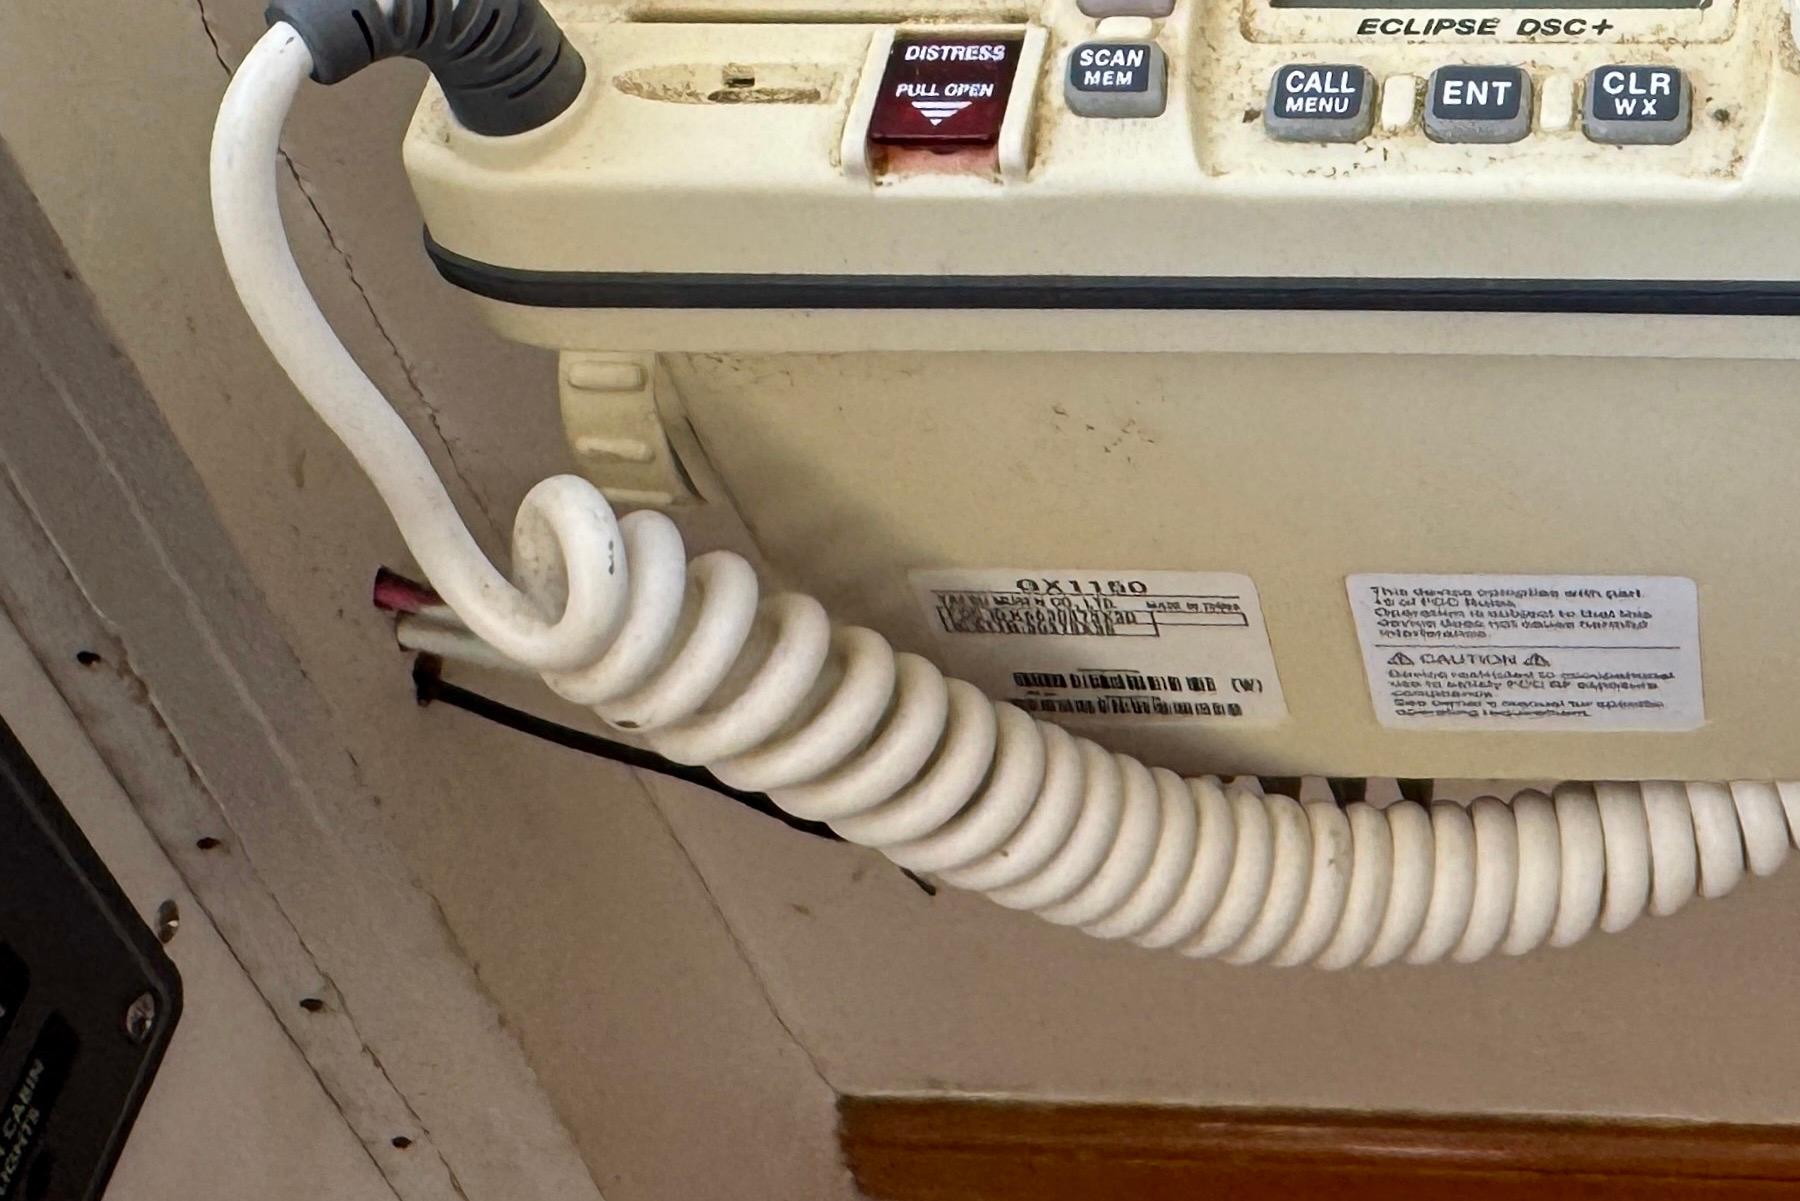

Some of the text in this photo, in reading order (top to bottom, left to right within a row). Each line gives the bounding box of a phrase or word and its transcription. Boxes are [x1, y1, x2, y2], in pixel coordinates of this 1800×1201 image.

[1356, 17, 1614, 36] ECLIPSE DSC+
[905, 44, 1006, 61] DISTRESS
[1079, 48, 1144, 68] SCAN
[1083, 70, 1133, 86] MEM
[1285, 70, 1356, 94] CALL
[1602, 71, 1671, 96] CLR
[895, 83, 995, 98] PULL OPEN
[1442, 80, 1513, 105] ENT
[1285, 96, 1350, 114] MENU
[1419, 653, 1517, 666] CAUTION
[1231, 677, 1264, 695] (W)
